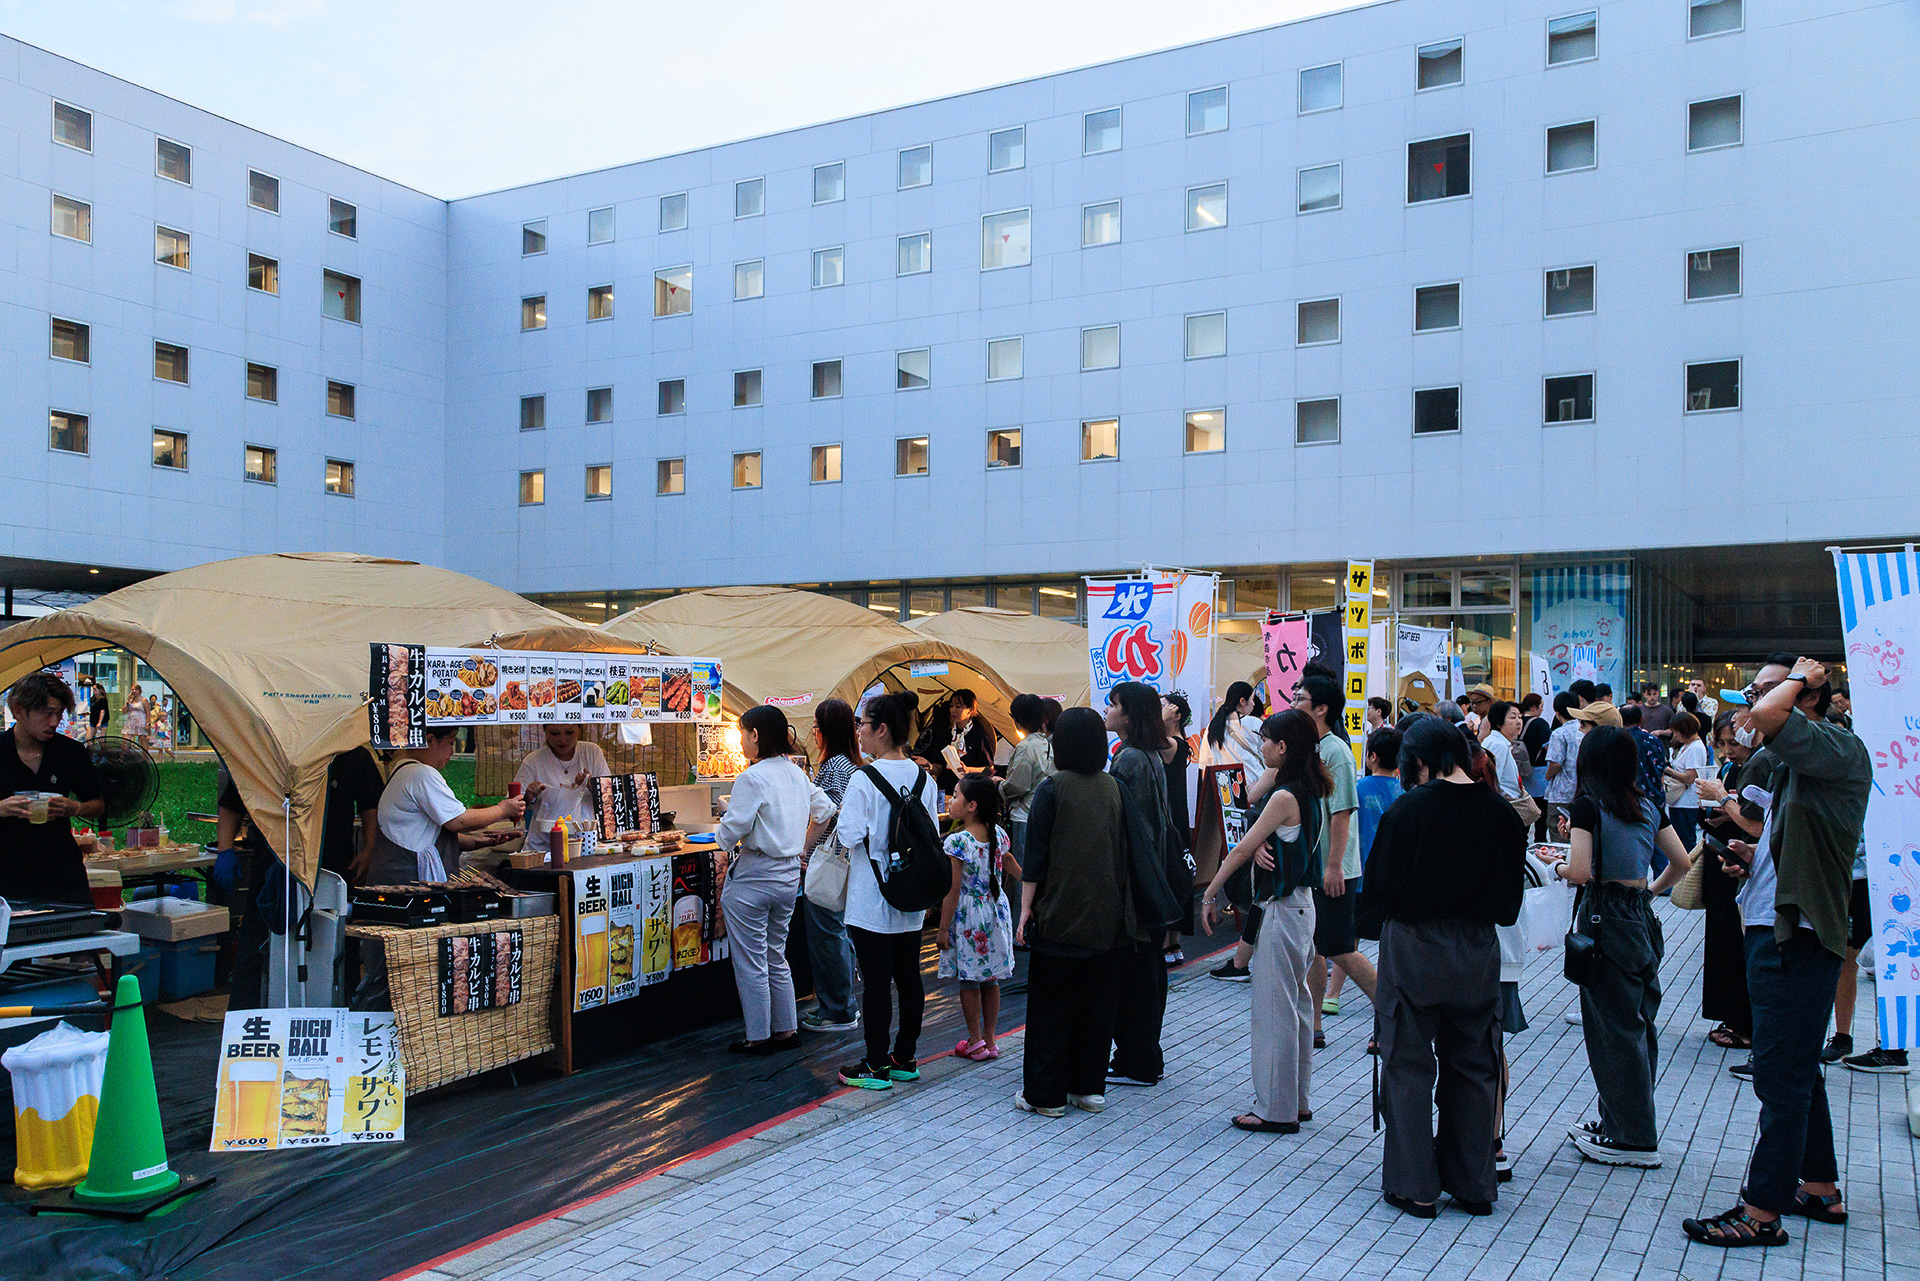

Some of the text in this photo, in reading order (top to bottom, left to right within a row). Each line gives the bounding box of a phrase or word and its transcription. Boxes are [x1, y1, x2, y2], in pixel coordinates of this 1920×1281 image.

[427, 660, 463, 669] KARA-AGE
[530, 666, 554, 675] たこ焼き
[609, 665, 627, 677] 枝豆
[432, 669, 459, 678] POTATO
[439, 678, 451, 687] SET
[408, 648, 425, 748] 牛カルビ串
[767, 696, 804, 706] Coleman
[564, 711, 581, 719] ¥350
[610, 710, 627, 719] ¥300
[372, 702, 381, 745] ¥800
[646, 773, 661, 833] 牛カルビ串
[585, 875, 601, 899] 生
[610, 872, 634, 891] HIGH
[578, 898, 607, 915] BEER
[611, 889, 633, 908] BALL
[648, 865, 662, 973] レモンサワー
[468, 936, 482, 1012] 牛カルビ串
[509, 932, 522, 1005] 牛カルビ串
[645, 972, 665, 983] ¥500
[579, 986, 603, 1004] ¥600
[615, 981, 635, 997] ¥500
[242, 1016, 271, 1041] 生
[289, 1019, 332, 1038] HIGH
[227, 1043, 281, 1058] BEER
[288, 1038, 329, 1057] BALL
[356, 1017, 385, 1132] レモンサワー
[223, 1137, 269, 1146] ¥600
[286, 1136, 331, 1145] ¥500
[352, 1131, 395, 1140] ¥500
